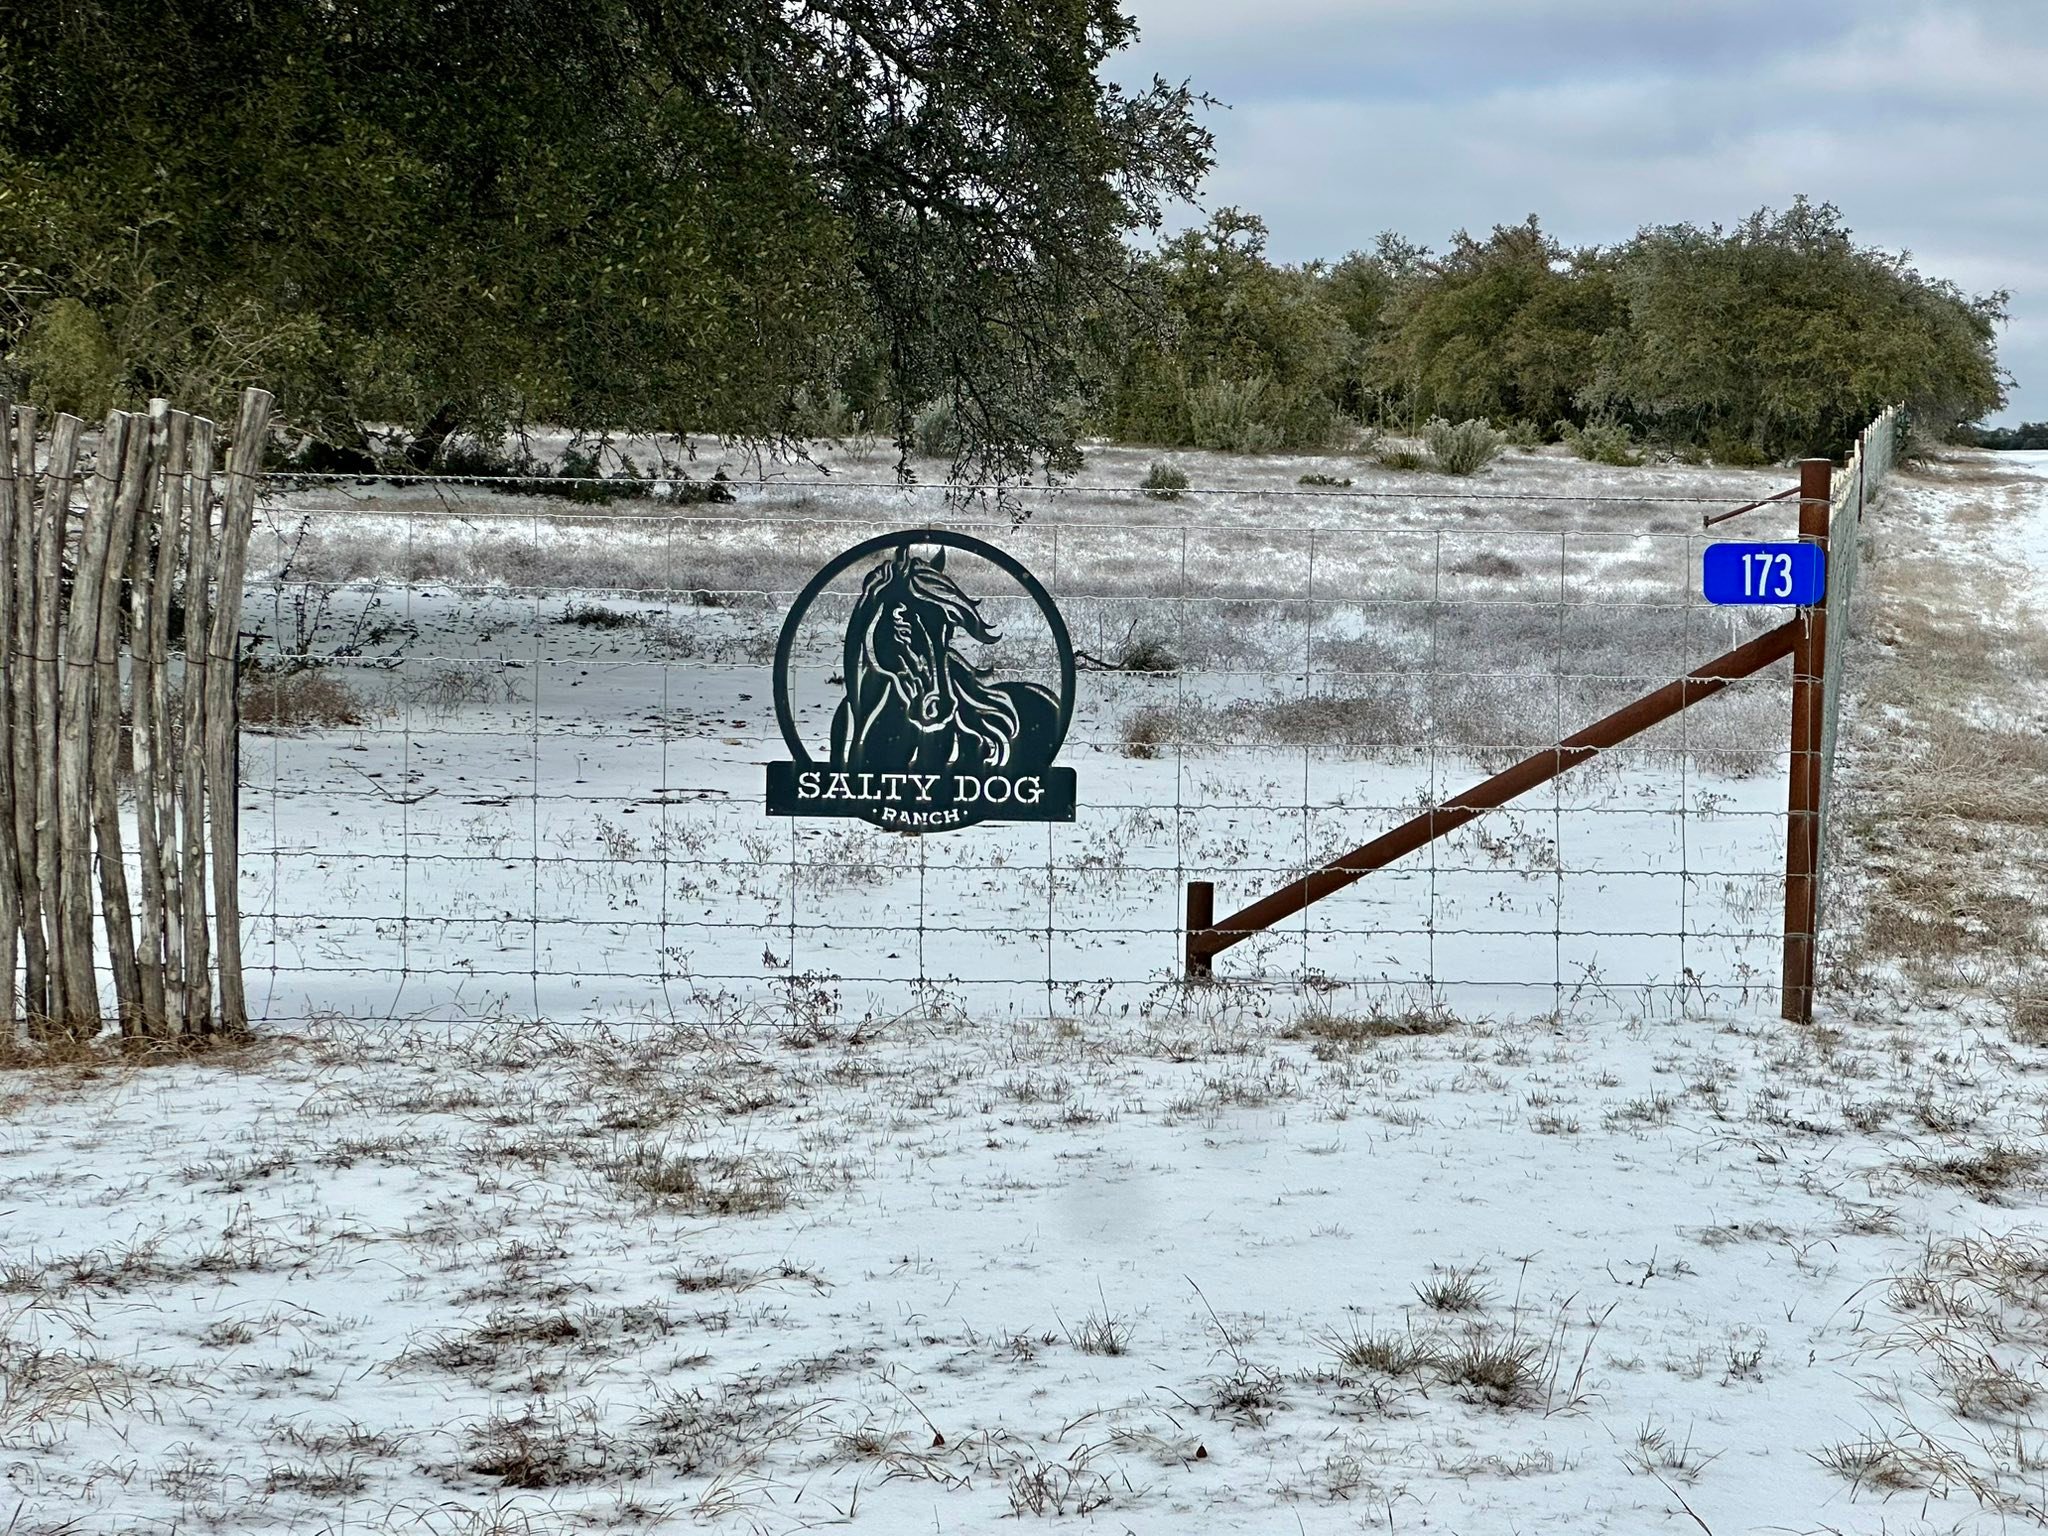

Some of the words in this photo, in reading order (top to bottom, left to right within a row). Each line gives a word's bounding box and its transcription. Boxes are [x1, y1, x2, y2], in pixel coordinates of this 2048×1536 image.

[1742, 553, 1793, 598] 173
[797, 771, 941, 801] SALTY
[953, 775, 1045, 804] DOG
[881, 806, 961, 825] RANCH
